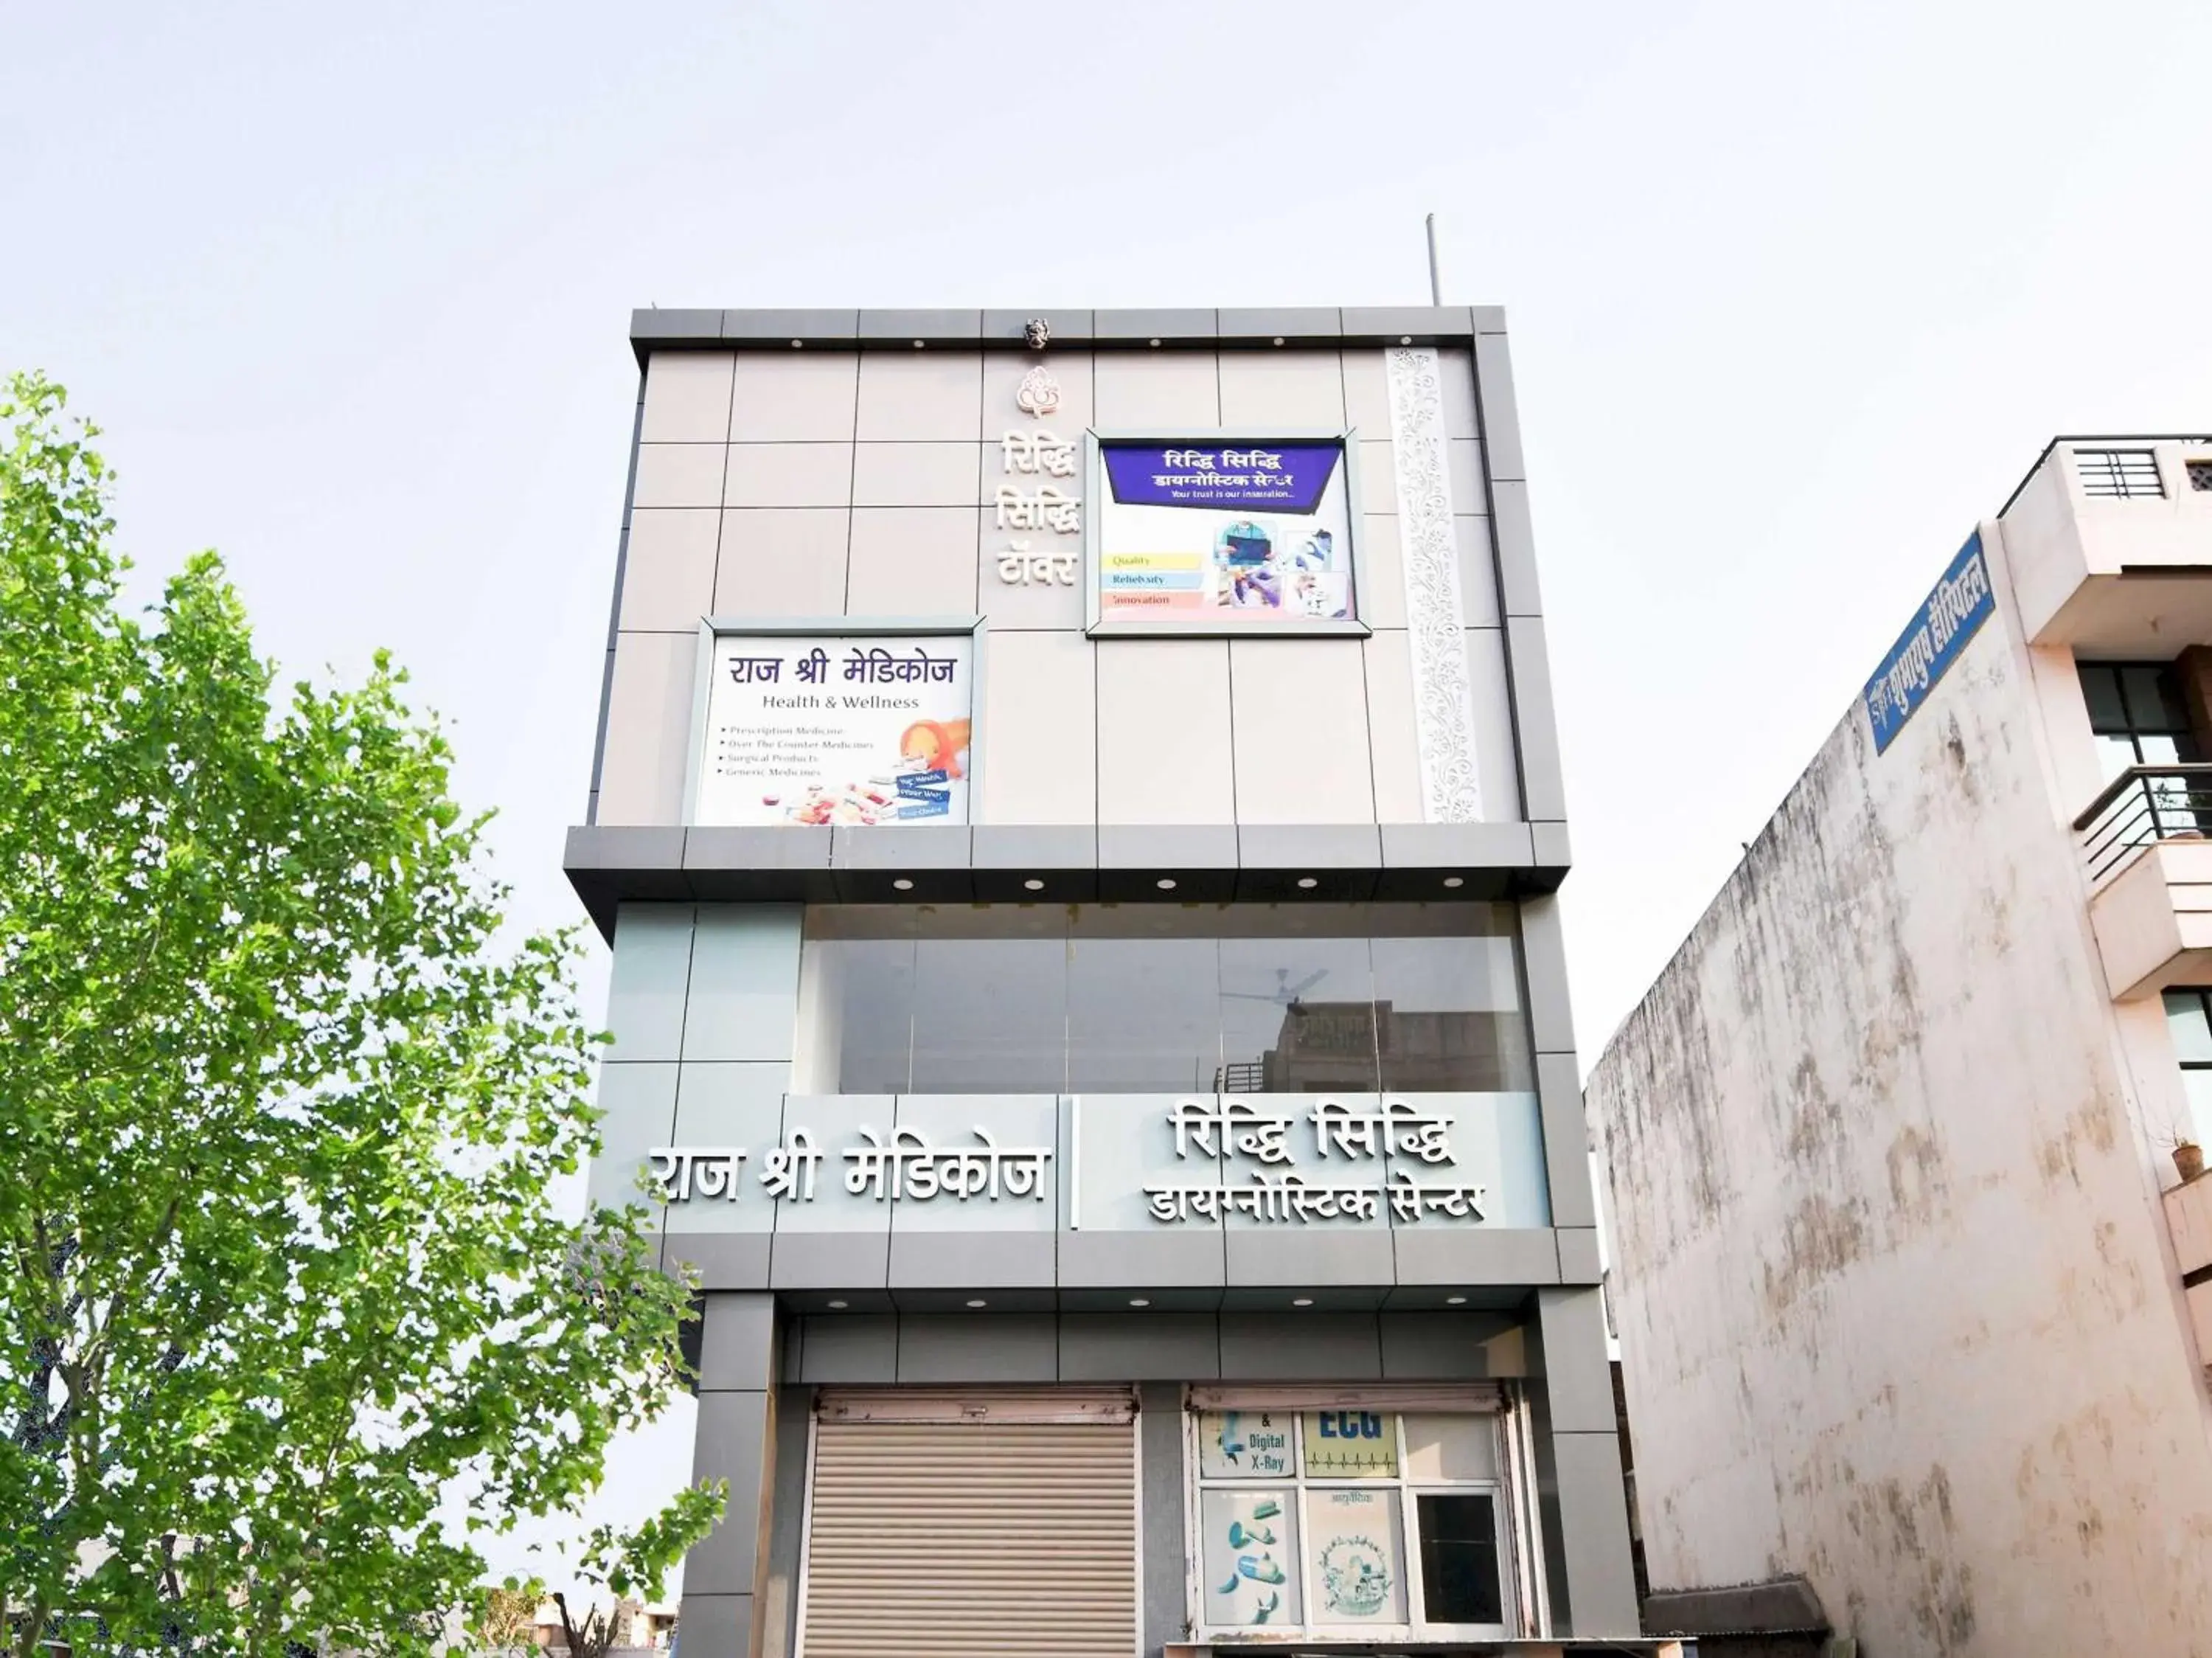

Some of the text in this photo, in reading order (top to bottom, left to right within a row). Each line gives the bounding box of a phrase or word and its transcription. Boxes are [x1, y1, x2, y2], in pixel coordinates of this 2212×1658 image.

[1002, 429, 1077, 477] रिद्धि
[1162, 450, 1282, 469] रिद्धि सिद्धि
[1172, 490, 1190, 499] Your
[1193, 490, 1213, 499] trust
[1217, 490, 1223, 499] is
[995, 484, 1082, 535] सिद्धि
[998, 539, 1078, 586] टॉवर
[1113, 556, 1150, 567] Quality
[728, 648, 957, 684] राज श्री मेडिकोज
[762, 695, 919, 709] Health & Wellness
[1166, 1097, 1457, 1165] रिद्धि सिद्धि
[648, 1123, 1052, 1201] राज श्री मेडिकोज
[1142, 1168, 1486, 1222] डायग्नोस्टिक सेन्टर
[1262, 1413, 1270, 1427] &
[1319, 1410, 1381, 1438] ECG
[1250, 1433, 1284, 1451] Digital
[1251, 1454, 1284, 1471] X-Ray
